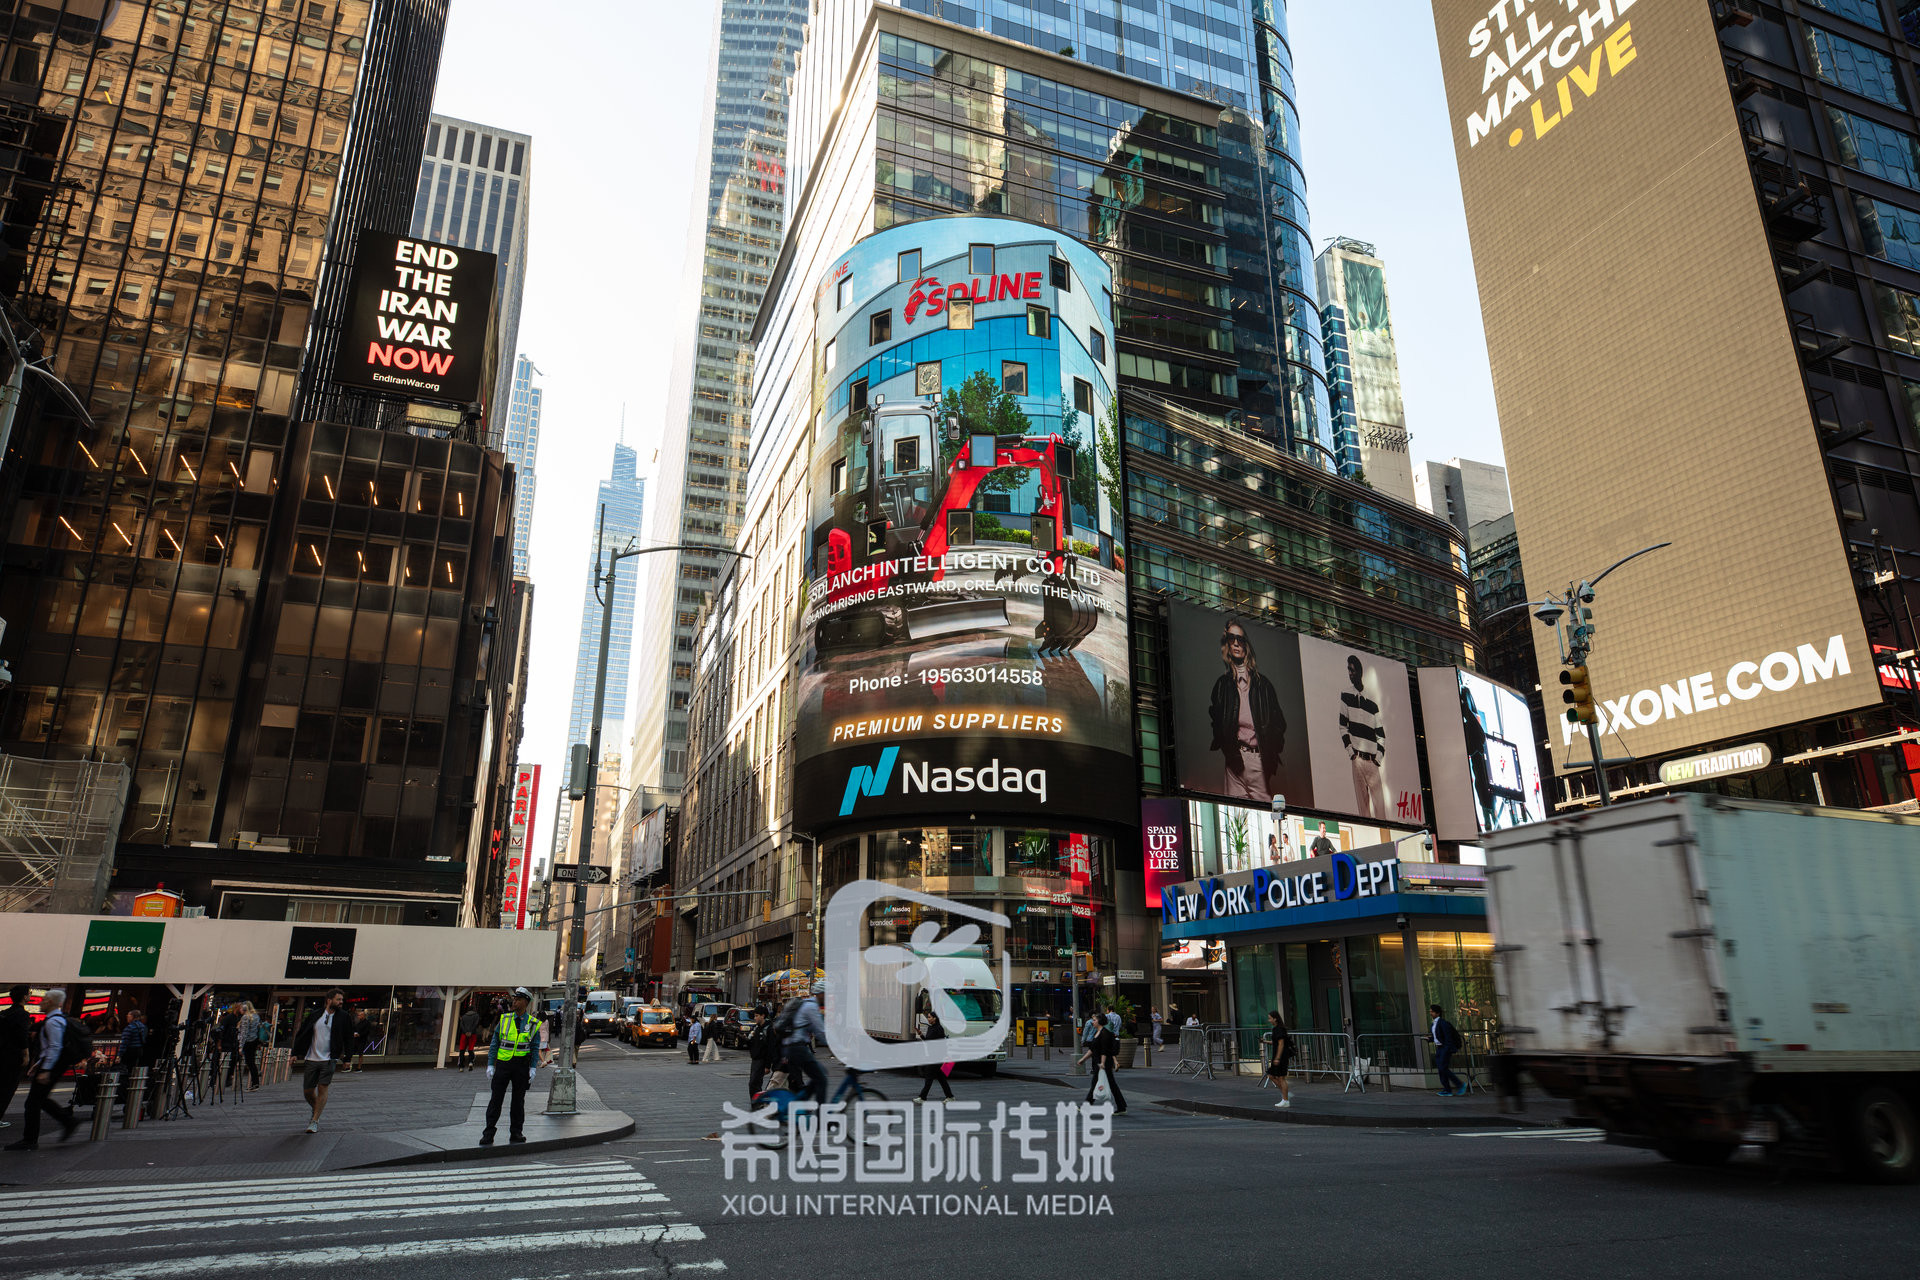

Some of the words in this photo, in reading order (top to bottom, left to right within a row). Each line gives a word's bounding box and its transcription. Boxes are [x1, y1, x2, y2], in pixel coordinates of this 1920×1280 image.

[1481, 11, 1553, 93] ALL
[1530, 20, 1637, 140] LIVE
[395, 240, 458, 269] END
[395, 266, 452, 296] THE
[379, 290, 458, 323] IRAN
[377, 316, 452, 349] WAR
[367, 341, 454, 376] NOW
[373, 373, 440, 392] EndIranWar.org
[811, 563, 875, 602] SDLANCH
[880, 552, 1019, 577] INTELLIGENT
[805, 600, 836, 628] SDLANCH
[838, 590, 876, 609] RISING
[878, 580, 961, 599] EASTWARD,
[964, 579, 1040, 595] CREATING
[1042, 584, 1068, 600] THE
[1071, 590, 1112, 612] FUTURE
[849, 671, 909, 694] Phone:
[918, 667, 1043, 686] 19563014558
[833, 715, 923, 742] PREMIUM
[933, 713, 1063, 733] SUPPLIERS
[902, 758, 1047, 804] Nasdaq
[514, 772, 530, 825] PARK
[1396, 791, 1422, 823] H&M
[1147, 826, 1176, 834] SPAIN
[1149, 835, 1178, 850] UP
[1149, 851, 1178, 859] YOUR
[1149, 859, 1179, 869] LIFE
[504, 858, 520, 912] PARK
[1161, 886, 1200, 924] NEW
[1199, 878, 1250, 919] YORK
[1253, 869, 1326, 912] POLICE
[1331, 853, 1398, 900] DEPT
[1026, 906, 1046, 914] Nasdaq
[89, 945, 142, 953] STARBUCKS
